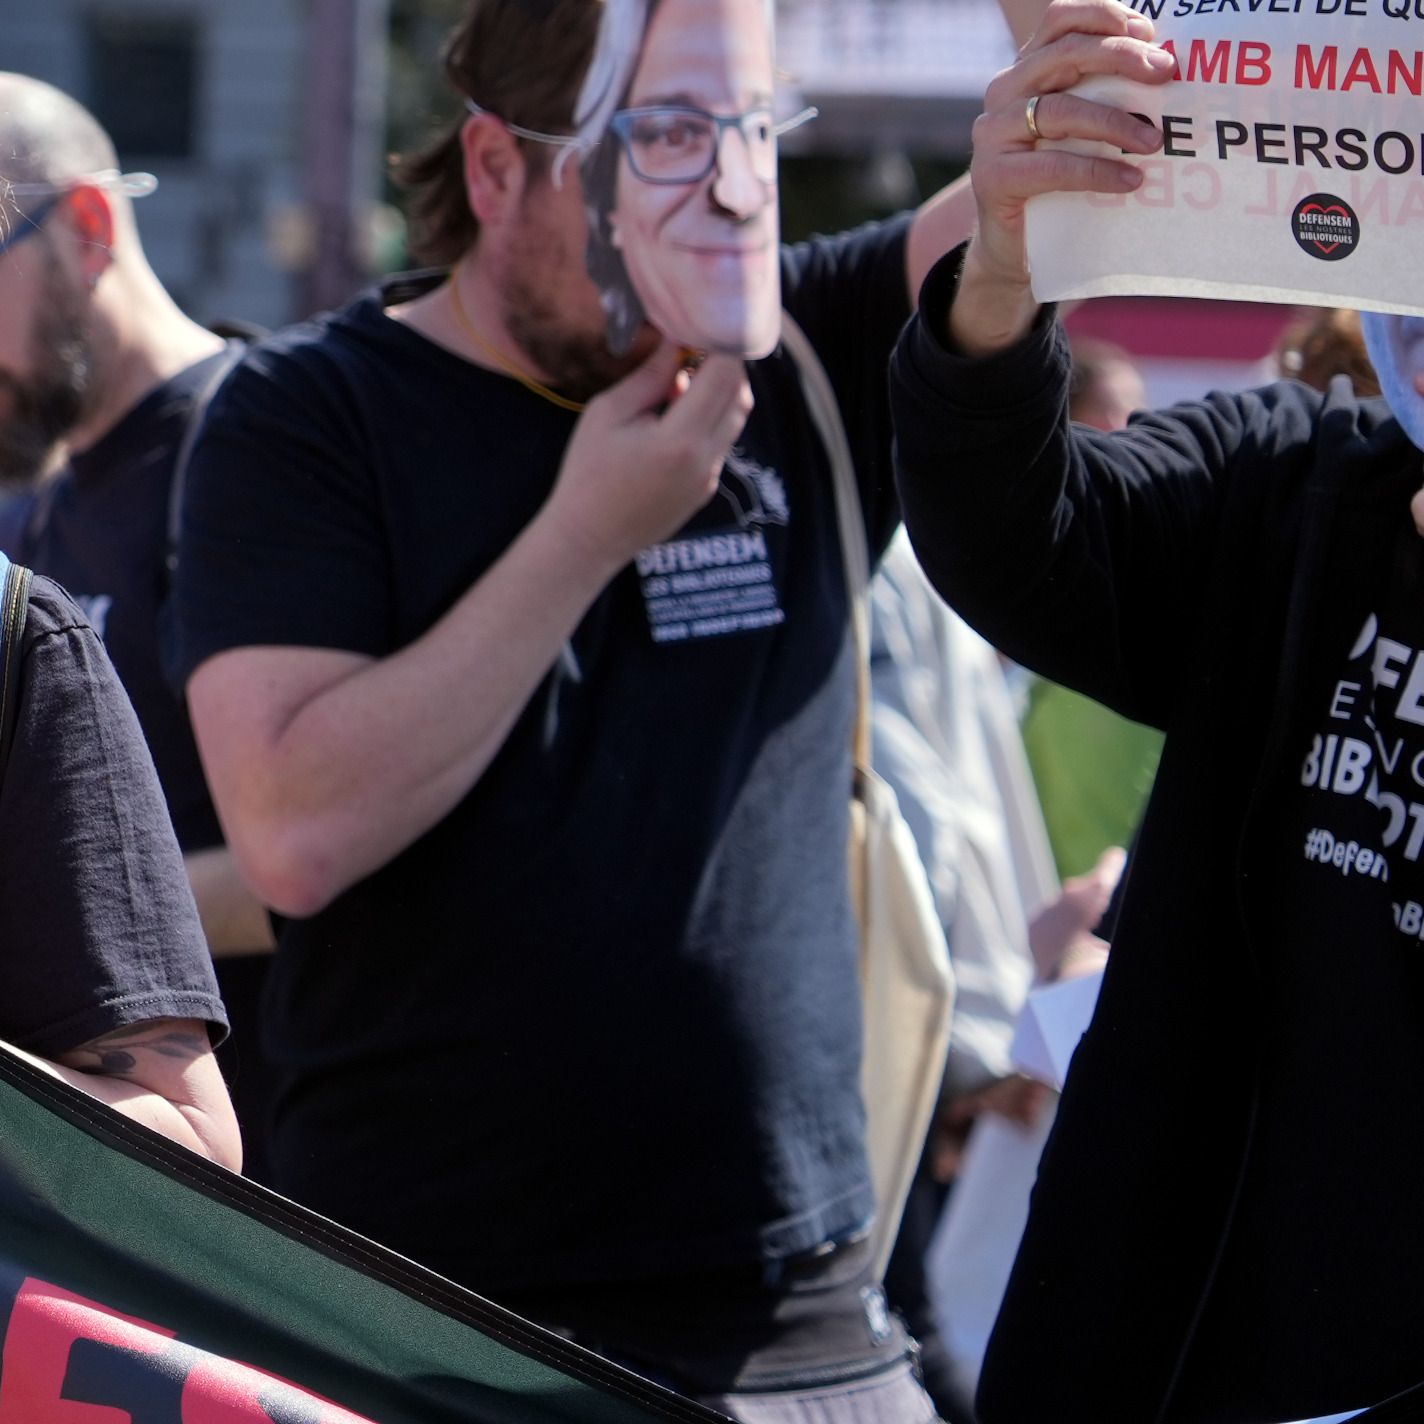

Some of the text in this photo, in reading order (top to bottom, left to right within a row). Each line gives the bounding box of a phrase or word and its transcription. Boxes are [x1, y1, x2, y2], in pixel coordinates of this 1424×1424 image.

[1294, 44, 1424, 97] MAN
[1122, 112, 1424, 176] E PERSO
[1299, 213, 1352, 228] DEFENSEM
[1300, 232, 1353, 245] BIBLIOTEQUES
[1304, 827, 1389, 883] #Defen
